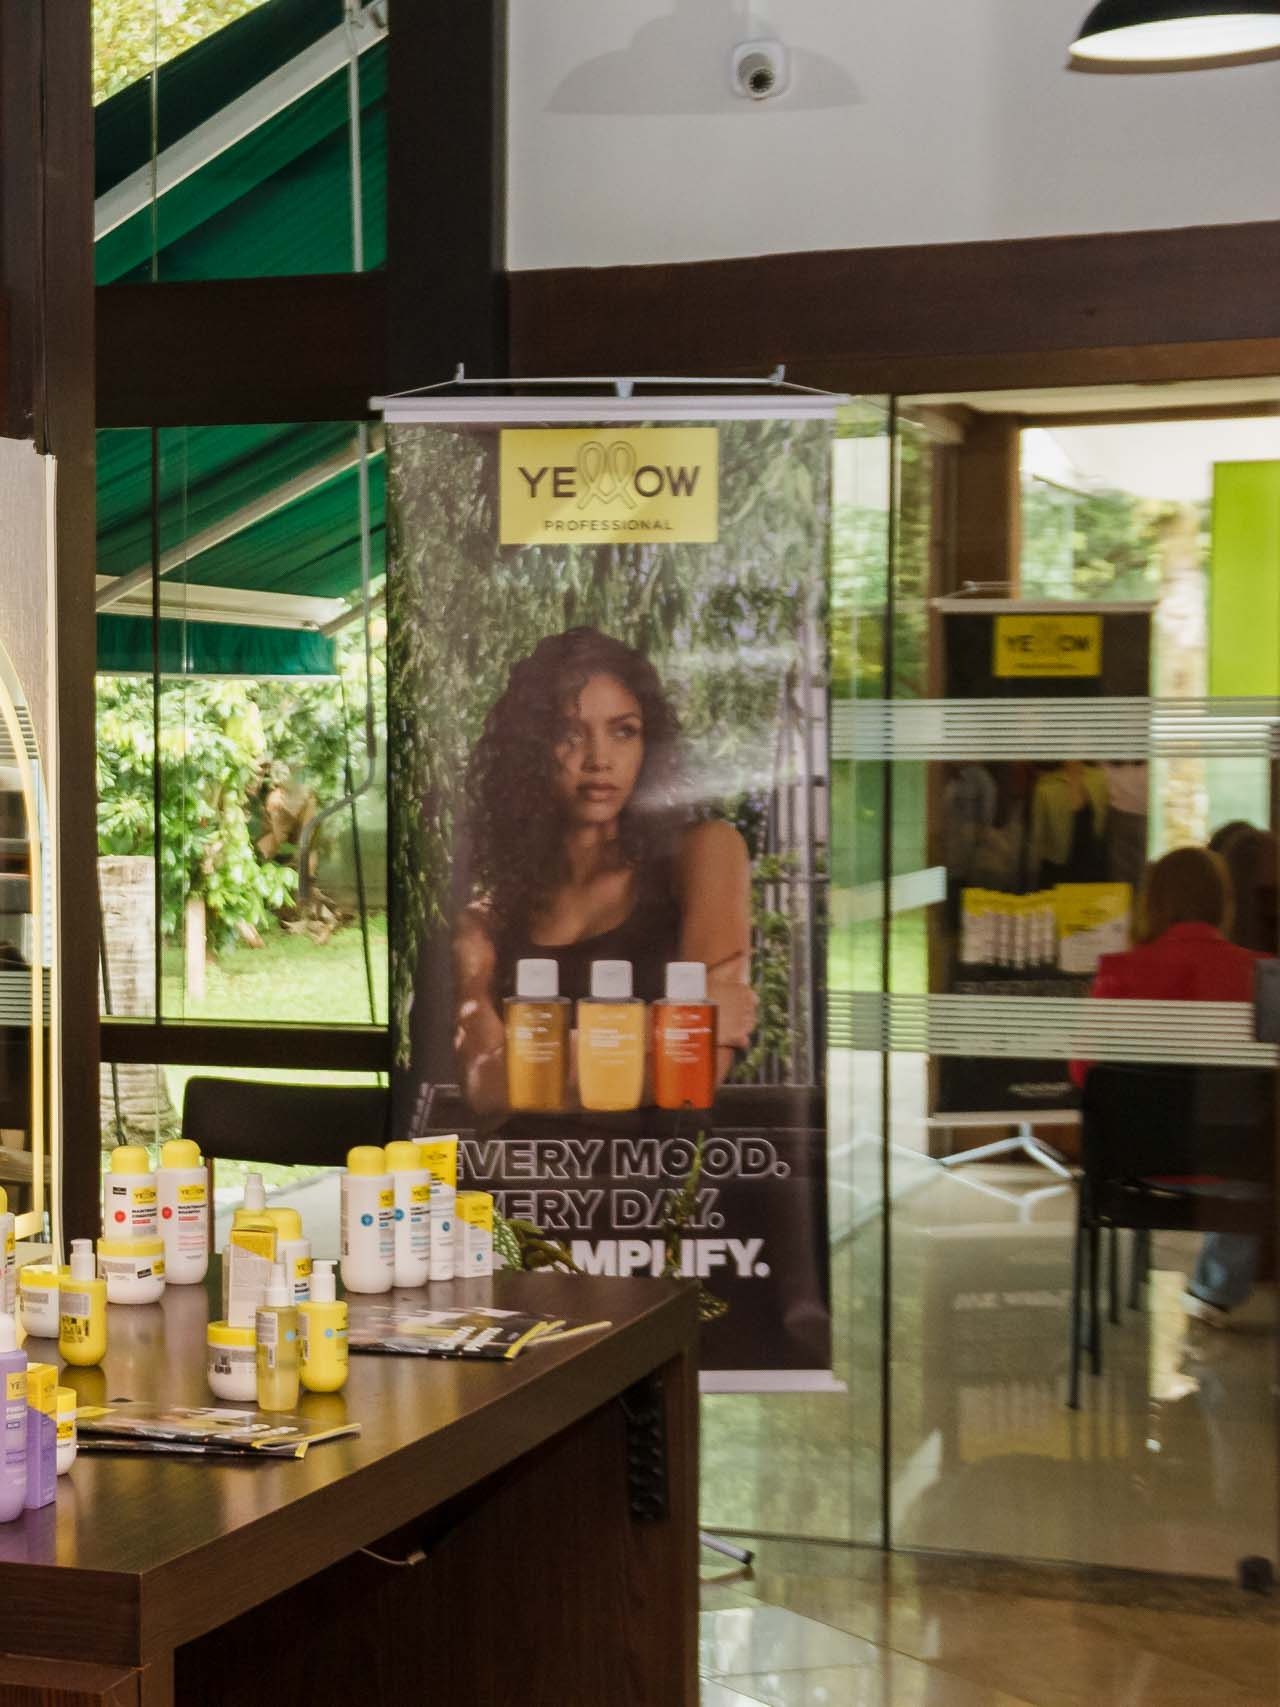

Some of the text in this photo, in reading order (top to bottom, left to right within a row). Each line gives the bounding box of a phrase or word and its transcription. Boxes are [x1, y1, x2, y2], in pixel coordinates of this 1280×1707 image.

[544, 519, 673, 531] PROFESSIONAL
[457, 1137, 791, 1180] VERY MOOD.
[488, 1190, 605, 1229] ERY
